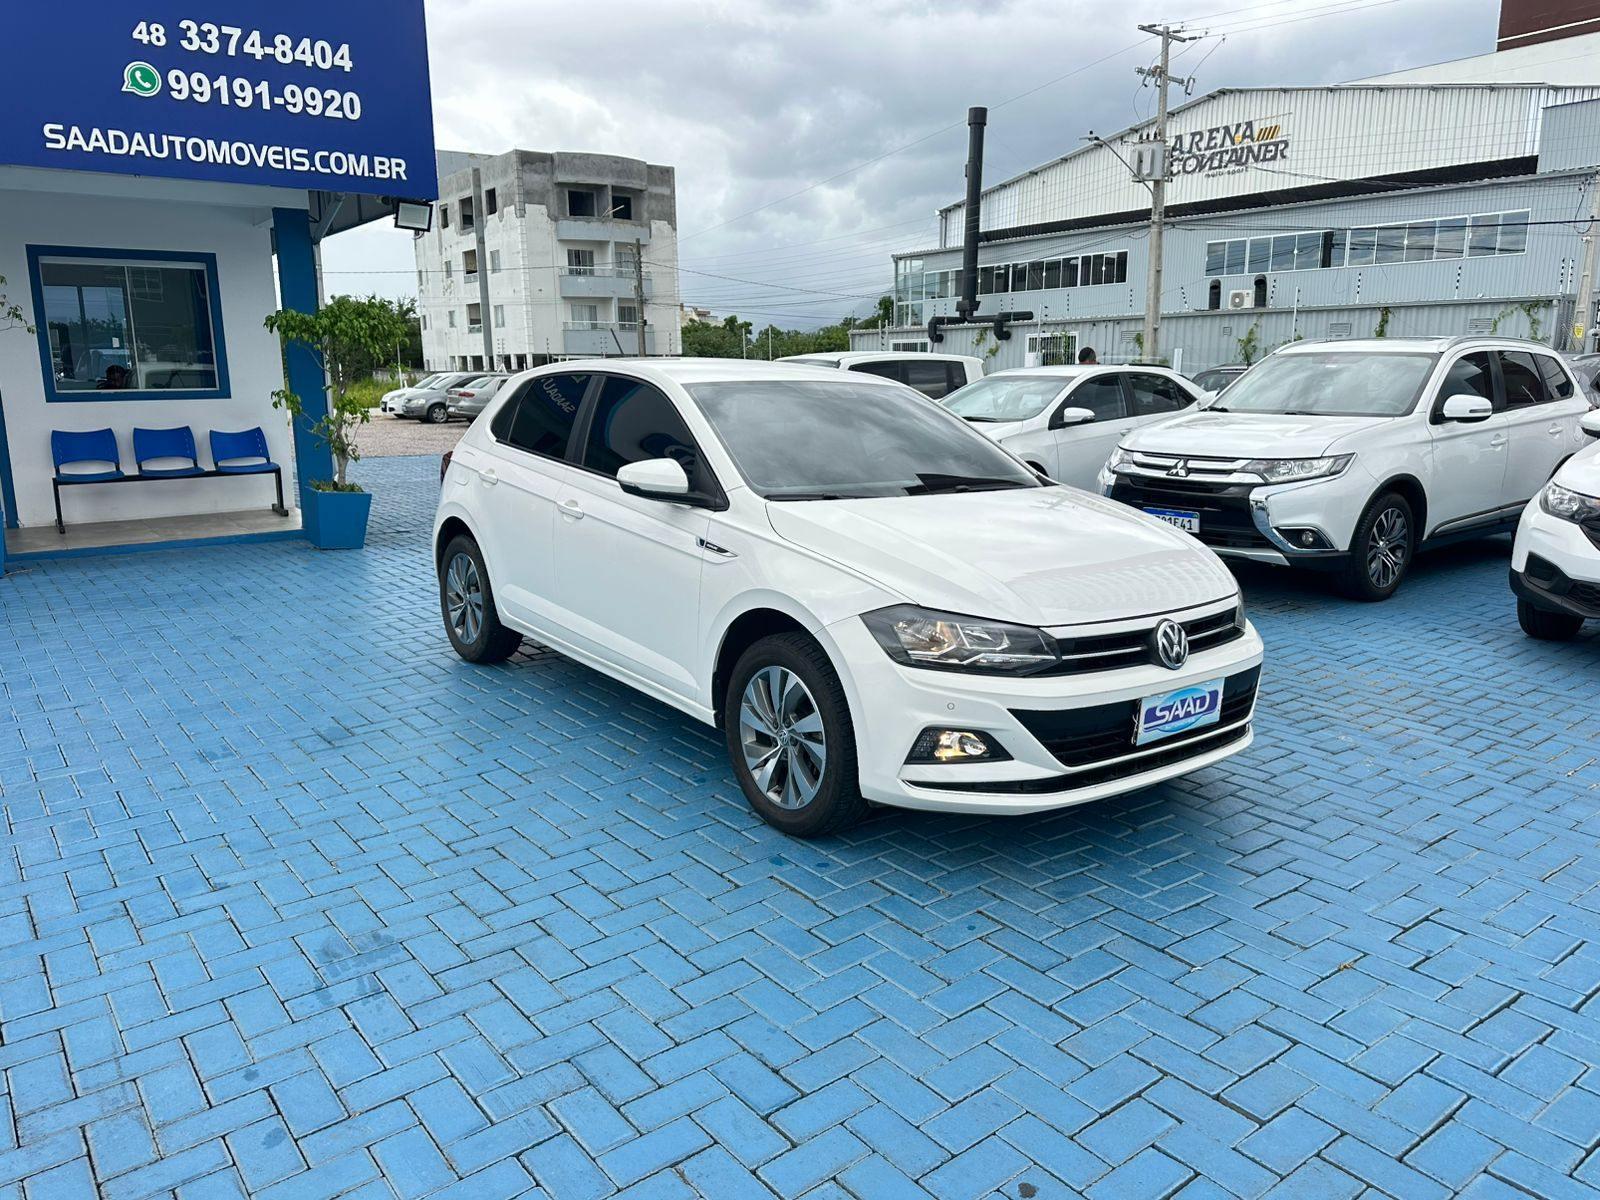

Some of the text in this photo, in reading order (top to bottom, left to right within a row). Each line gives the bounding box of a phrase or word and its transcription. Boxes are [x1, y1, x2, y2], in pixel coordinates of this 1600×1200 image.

[132, 19, 353, 72] 48 3374-8404
[167, 68, 362, 120] 99191-9920
[43, 123, 408, 181] SAADAUTOMOVEIS.COM.BR
[1170, 139, 1290, 177] CONTAINER
[1171, 121, 1256, 155] ARENA
[1155, 690, 1211, 722] SAAD
